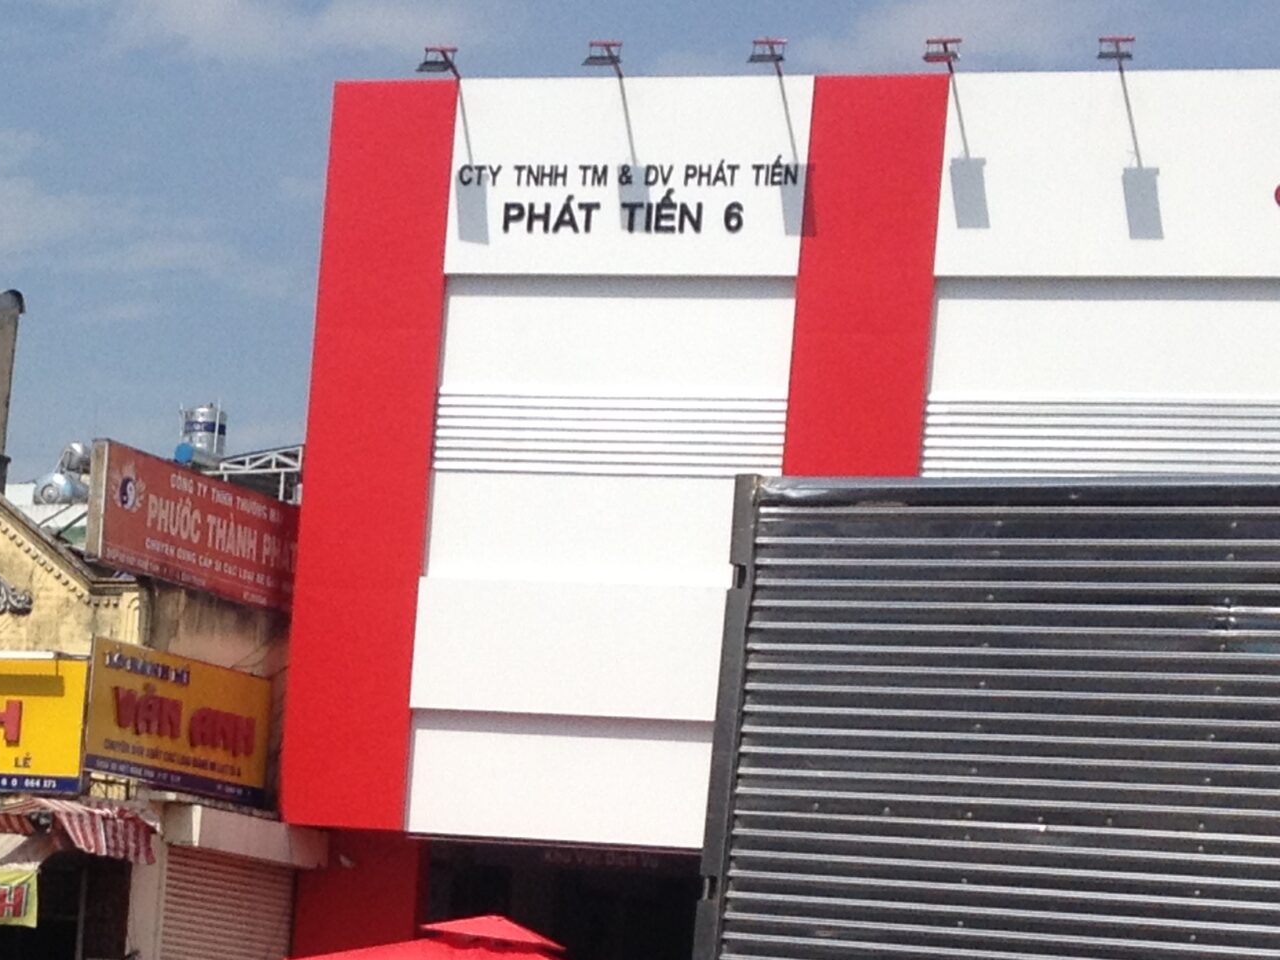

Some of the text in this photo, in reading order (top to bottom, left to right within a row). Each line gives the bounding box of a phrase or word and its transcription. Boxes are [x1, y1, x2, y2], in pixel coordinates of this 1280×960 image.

[458, 155, 799, 187] CTY TNHH TM & DV PHÁT TIẾN
[503, 188, 744, 233] PHÁT TIẾN 6
[146, 494, 201, 544] PHƯỚC
[207, 512, 258, 562] THÀNH
[189, 706, 257, 758] ANH
